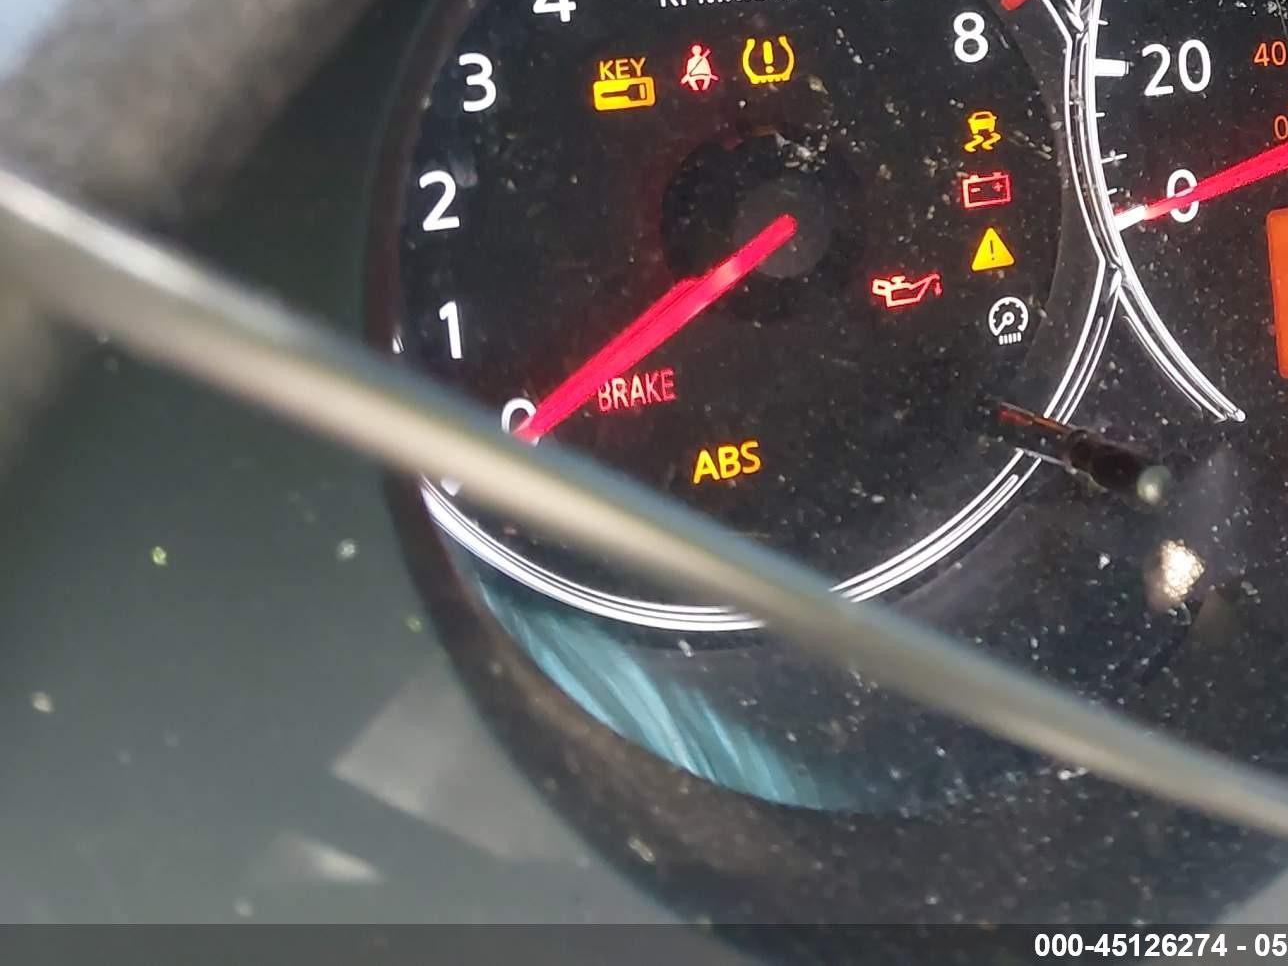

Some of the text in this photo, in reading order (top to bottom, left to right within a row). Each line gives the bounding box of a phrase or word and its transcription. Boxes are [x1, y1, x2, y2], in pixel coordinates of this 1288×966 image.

[953, 11, 989, 63] 8
[1253, 40, 1287, 67] 40
[458, 52, 497, 112] 3
[599, 57, 646, 80] KEY
[1141, 39, 1211, 97] 20
[419, 169, 460, 232] 2
[1166, 168, 1200, 223] 0
[438, 301, 462, 360] 1
[598, 369, 675, 411] BRAKE
[693, 440, 761, 484] ABS
